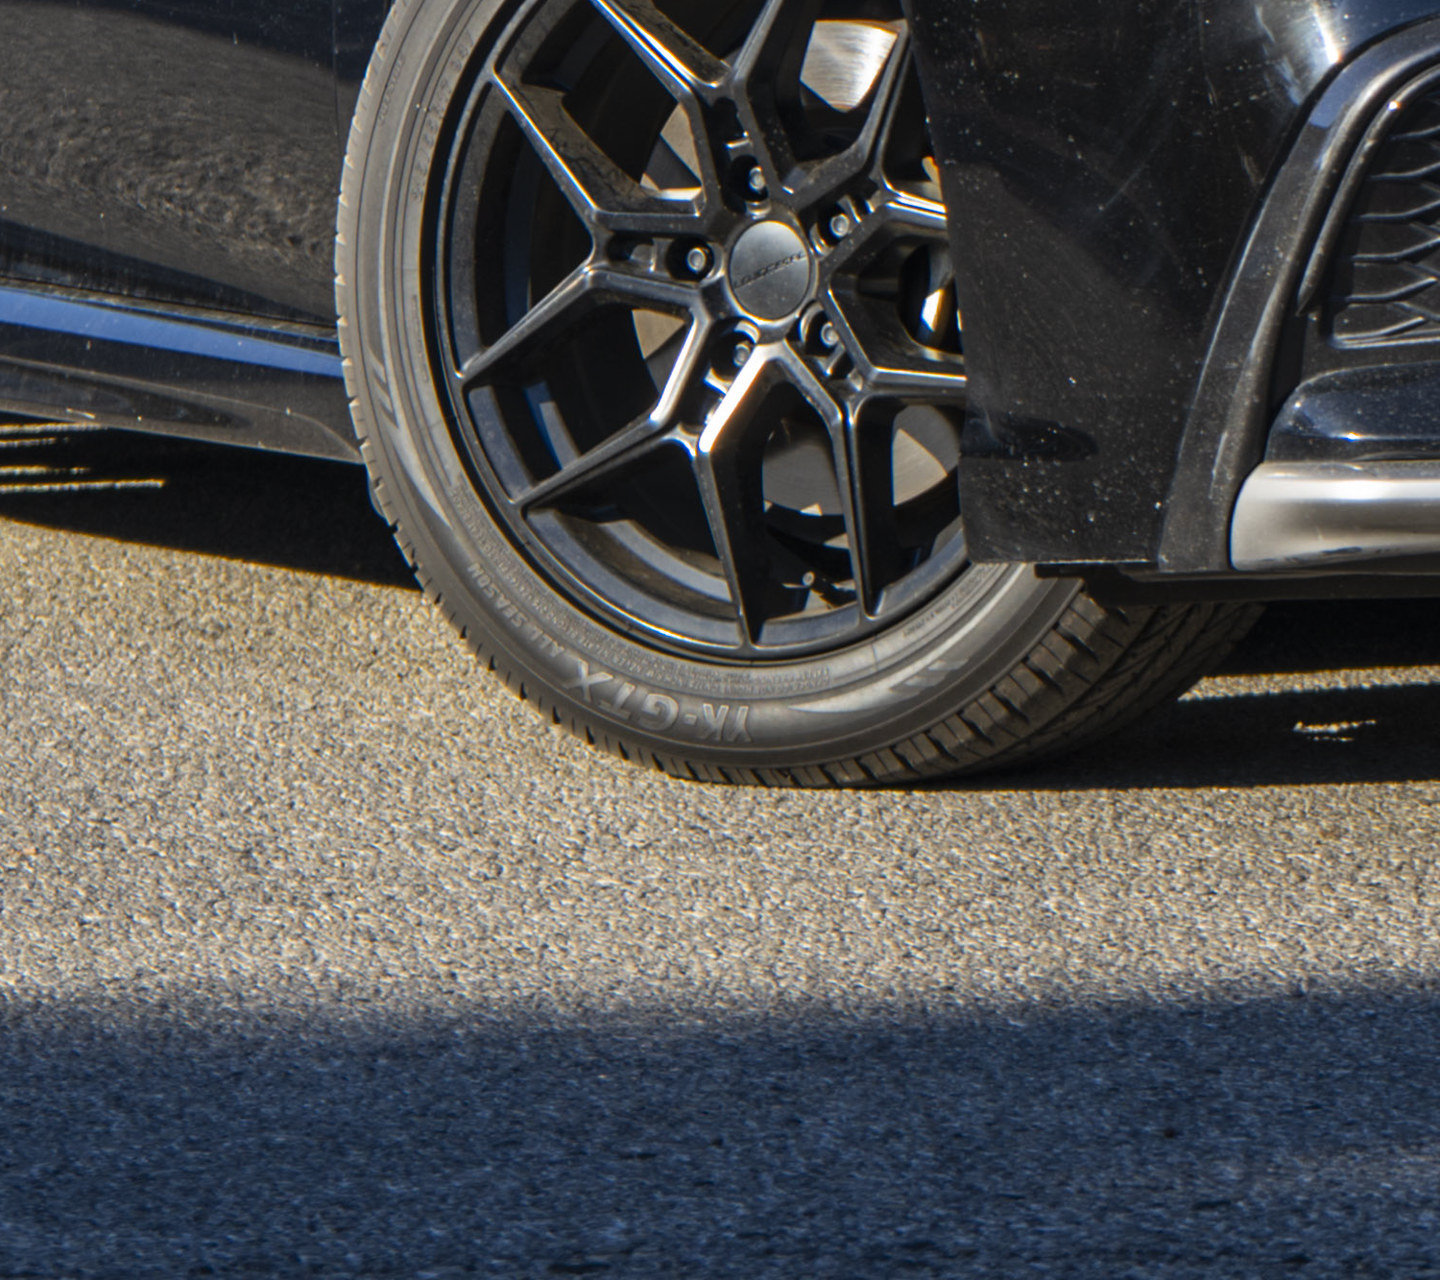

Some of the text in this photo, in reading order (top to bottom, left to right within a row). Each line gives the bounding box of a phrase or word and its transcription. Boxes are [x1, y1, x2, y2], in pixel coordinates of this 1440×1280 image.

[466, 561, 530, 628] SEASON
[530, 627, 566, 658] ALL
[566, 657, 753, 743] YK-GTX
